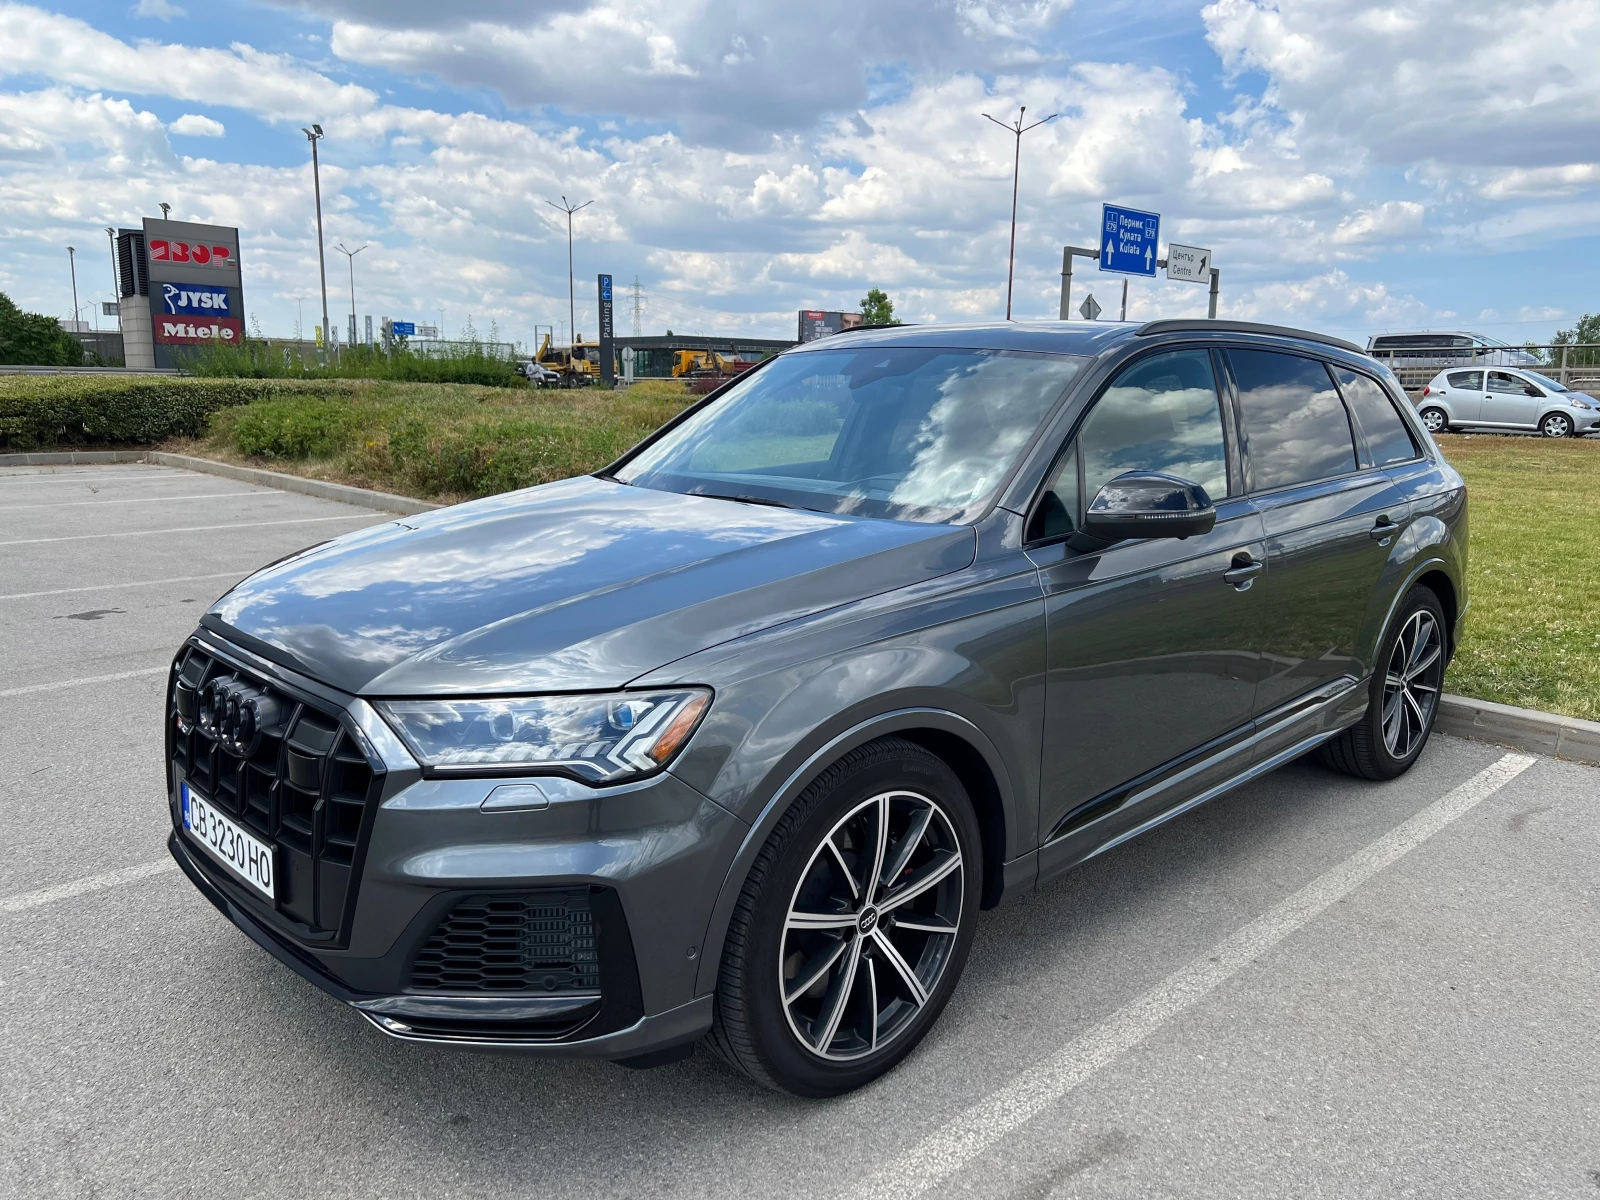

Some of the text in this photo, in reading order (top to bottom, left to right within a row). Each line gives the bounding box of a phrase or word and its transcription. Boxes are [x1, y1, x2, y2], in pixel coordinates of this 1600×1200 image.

[1107, 222, 1116, 231] E79
[1120, 215, 1143, 229] Перник
[1120, 229, 1141, 242] Кулата
[1145, 229, 1155, 238] E79
[149, 239, 231, 267] ЯВОР
[1120, 242, 1140, 255] Kulata
[1173, 249, 1194, 262] Център
[1173, 264, 1192, 276] Centre
[603, 277, 609, 287] P
[178, 291, 228, 310] JYSK
[603, 302, 611, 338] Parking
[162, 322, 234, 339] Miele
[190, 796, 271, 888] CB 3230 HO
